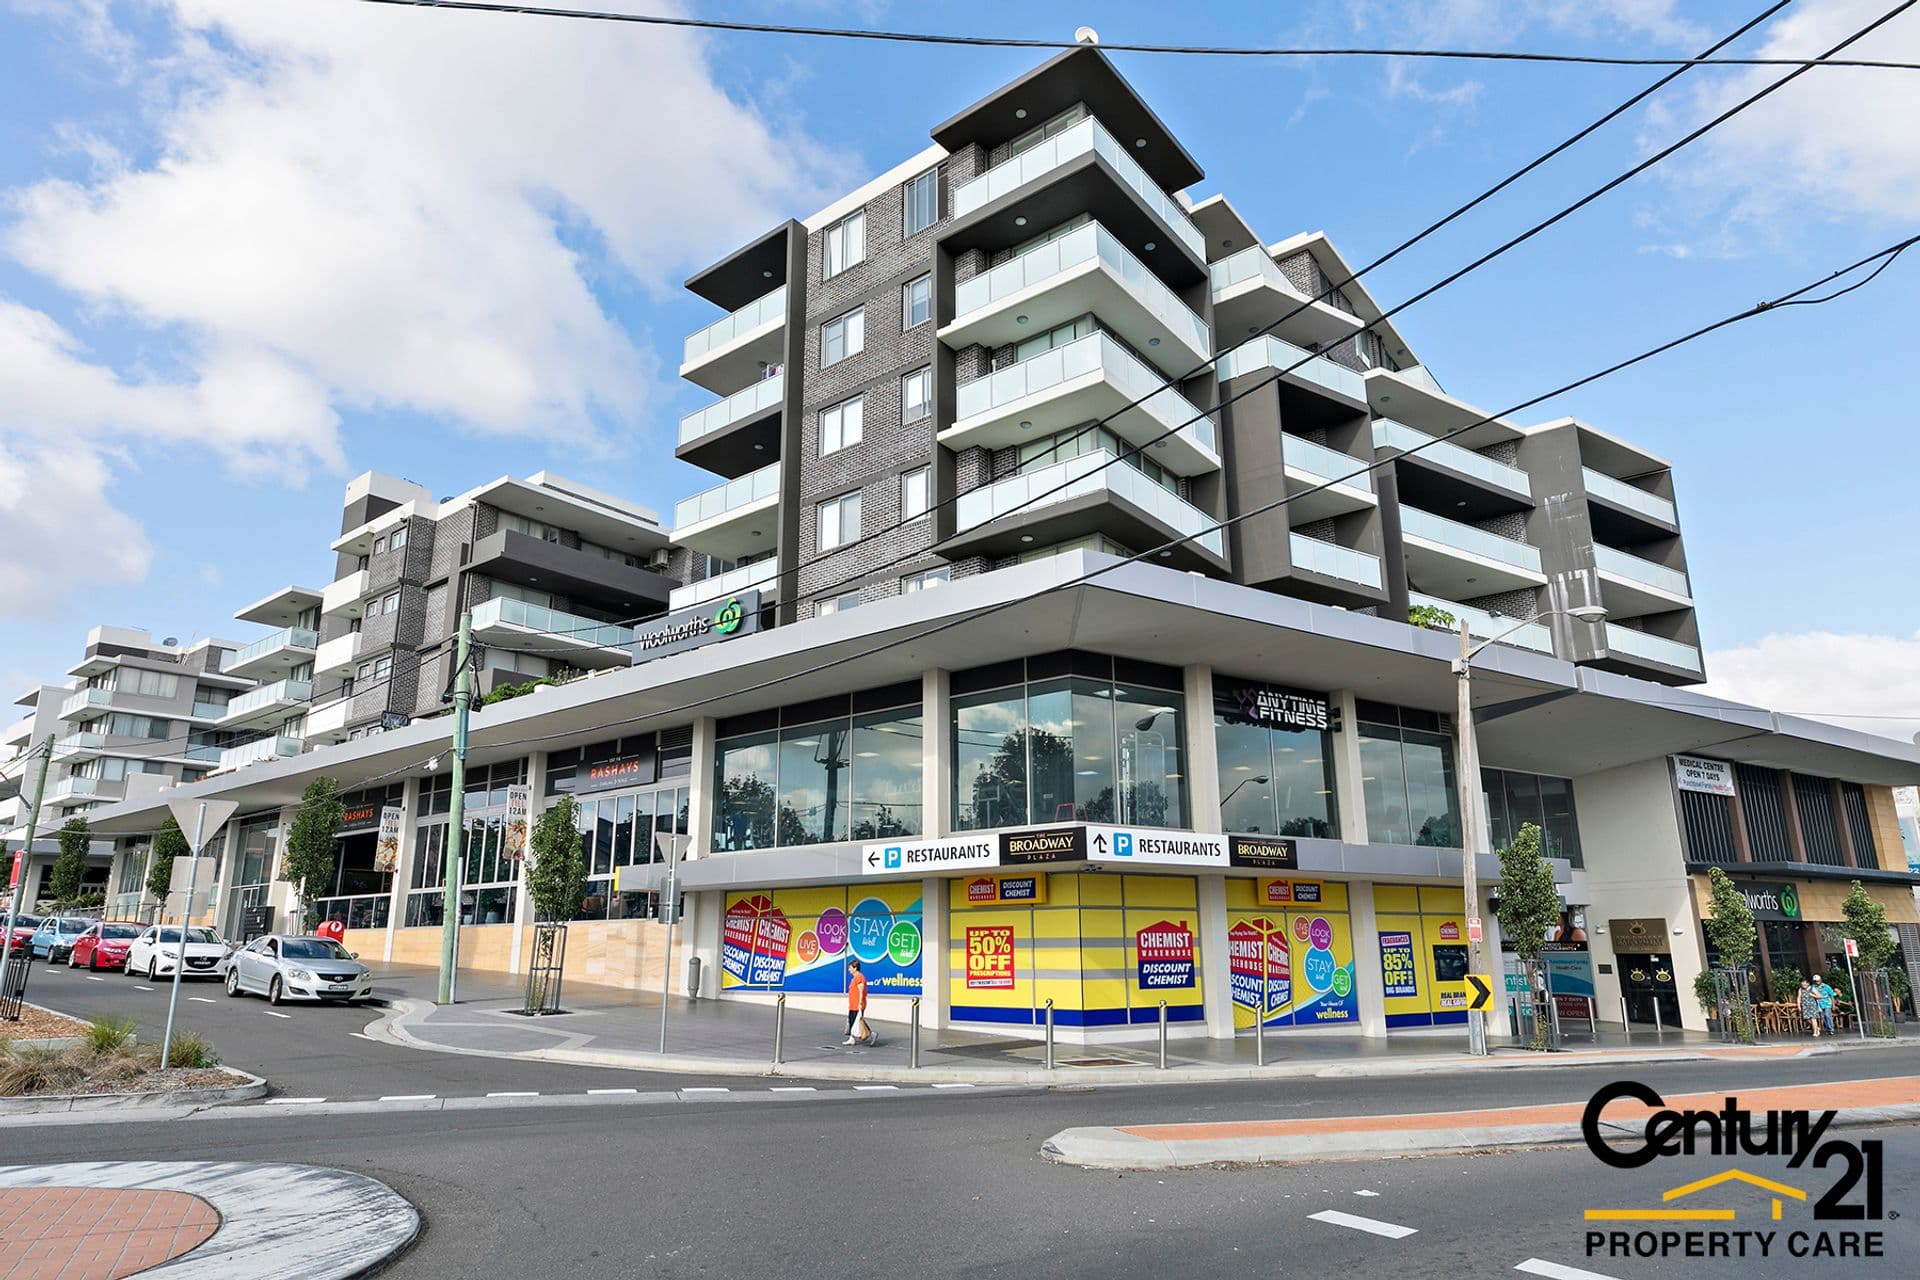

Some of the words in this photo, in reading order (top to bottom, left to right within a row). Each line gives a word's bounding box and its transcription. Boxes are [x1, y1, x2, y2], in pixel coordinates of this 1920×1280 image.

[640, 616, 710, 650] Woolworths
[1257, 690, 1326, 716] ANYTIME
[590, 761, 640, 780] RASHAYS
[1679, 758, 1703, 770] MEDICAL
[1703, 762, 1725, 773] CENTRE
[1685, 769, 1701, 779] OPEN
[1706, 772, 1721, 782] DAYS
[510, 791, 527, 800] OPEN
[343, 808, 374, 821] RASHAYS
[383, 812, 400, 820] OPEN
[1009, 836, 1074, 852] BROADWAY
[1139, 838, 1221, 857] RESTAURANTS
[1237, 844, 1288, 857] BROADWAY
[907, 843, 990, 863] RESTAURANTS
[970, 884, 994, 894] CHEMIST
[1003, 880, 1033, 889] DISCOUNT
[1005, 889, 1031, 897] CHEMIST
[819, 922, 846, 937] LOOK
[853, 917, 889, 937] STAY
[1311, 927, 1330, 938] LOOK
[800, 939, 816, 950] LIVE
[890, 932, 918, 950] GET
[970, 936, 1011, 955] 50%
[1140, 932, 1190, 948] CHEMIST
[1141, 949, 1191, 957] WAREHOUSE
[1229, 940, 1263, 959] HEMIST
[753, 956, 785, 971] DISCOUNT
[970, 955, 1011, 970] OFF
[1143, 963, 1191, 974] DISCOUNT
[1307, 958, 1332, 973] STAY
[1383, 953, 1413, 970] 85%
[1147, 974, 1188, 985] CHEMIST
[1333, 974, 1349, 985] GET
[1384, 970, 1407, 986] OFF
[1231, 987, 1260, 1005] HEMIST
[1385, 986, 1395, 994] BIG
[1440, 991, 1452, 999] REAL
[1315, 1007, 1349, 1020] wellness
